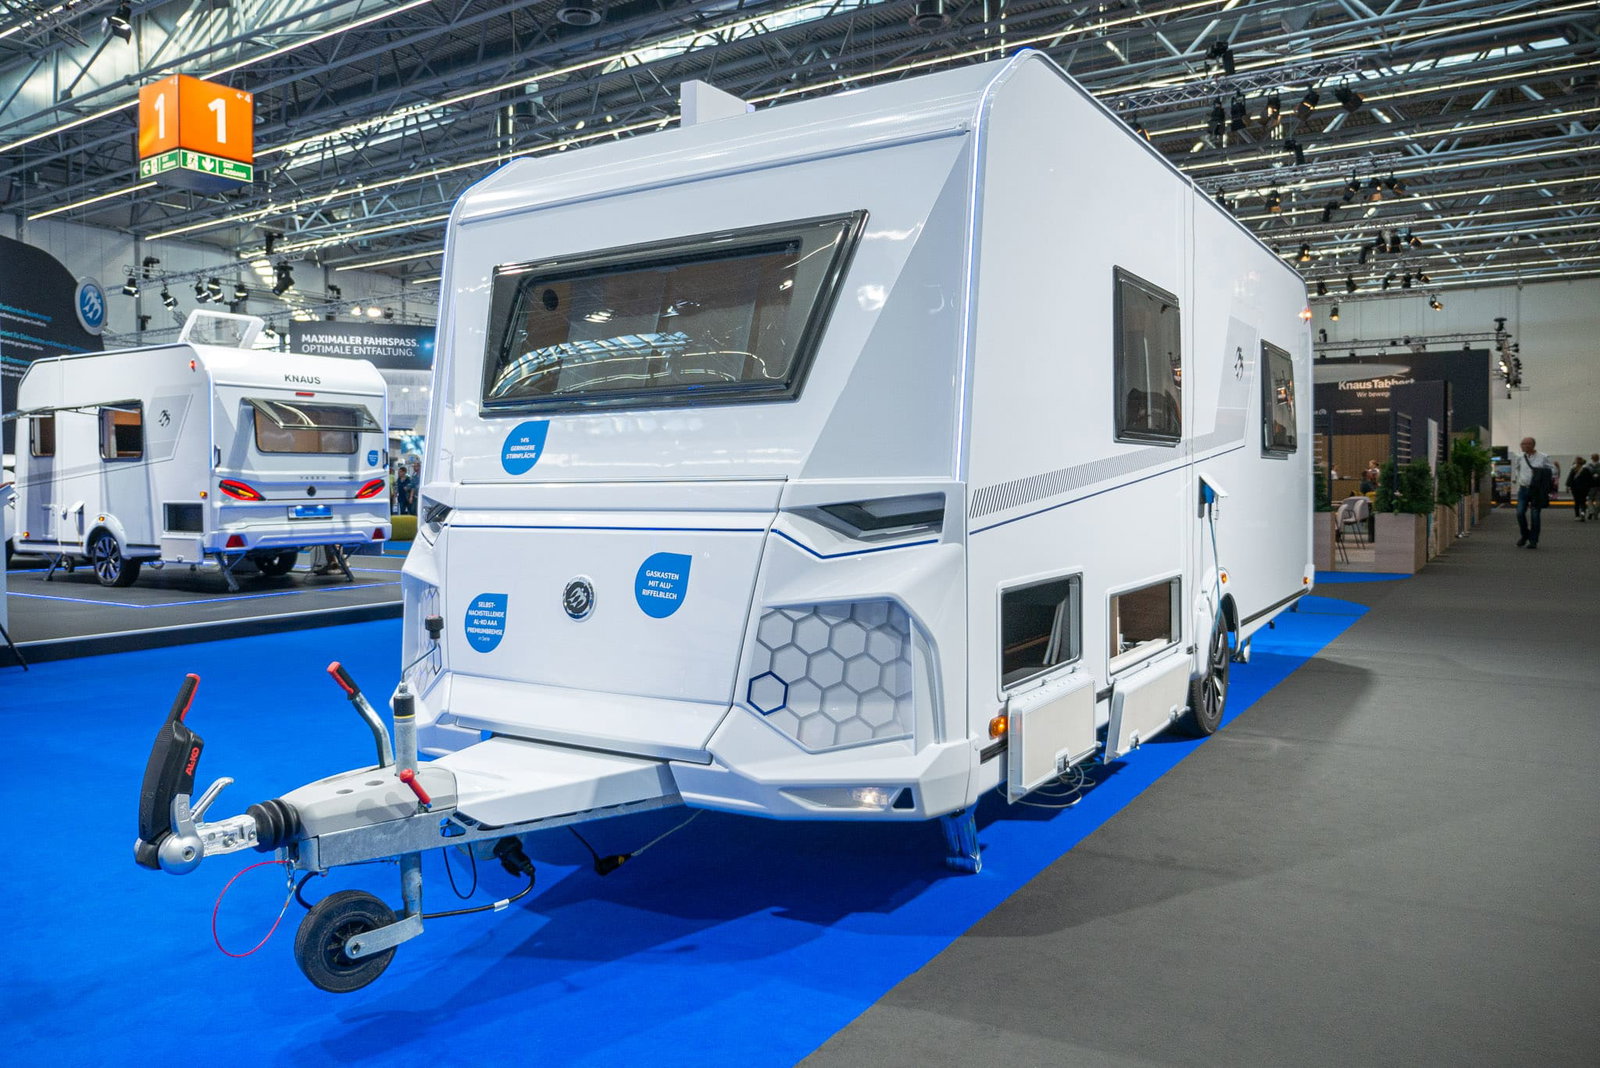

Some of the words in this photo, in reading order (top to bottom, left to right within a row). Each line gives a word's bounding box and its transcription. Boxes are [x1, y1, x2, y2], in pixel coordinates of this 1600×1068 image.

[154, 93, 165, 139] 1
[207, 97, 227, 144] 1
[301, 334, 362, 345] MAXIMALER
[363, 335, 420, 347] FAHRSPASS.
[301, 344, 352, 355] OPTIMALE
[353, 346, 416, 357] ENTFALTUNG.
[284, 374, 321, 384] KNAUS
[645, 570, 680, 580] GASKASTEN
[659, 581, 674, 589] ALU-
[641, 588, 678, 600] RIFFELBLECH
